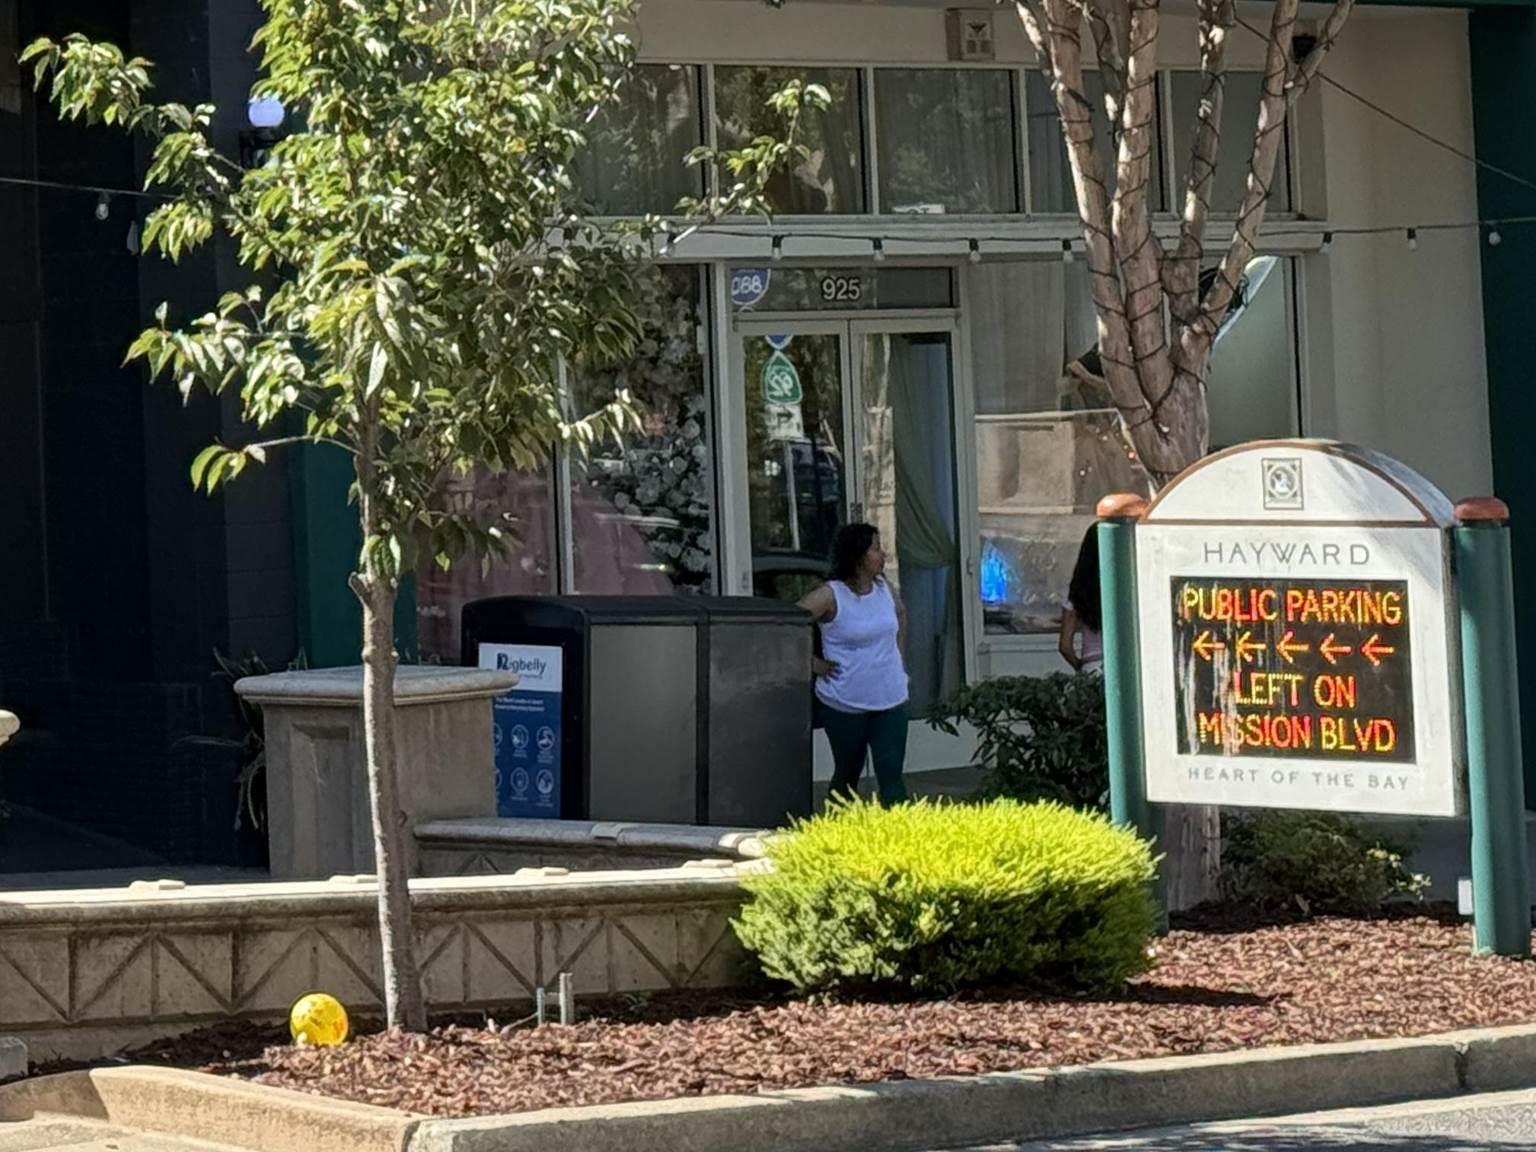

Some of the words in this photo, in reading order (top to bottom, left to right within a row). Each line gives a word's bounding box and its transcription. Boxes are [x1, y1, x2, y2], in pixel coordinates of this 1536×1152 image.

[822, 278, 860, 299] 925
[1203, 541, 1370, 566] HAYWARD
[1182, 586, 1278, 622] PUBLIC
[1286, 589, 1402, 626] PARKING
[1233, 671, 1304, 707] LEFT
[1313, 674, 1357, 709] ON
[1198, 712, 1312, 749] MISSION
[1319, 715, 1396, 753] BLVD
[1187, 767, 1260, 784] HEART
[1270, 769, 1301, 785] OF
[1311, 772, 1355, 788] THE
[1367, 774, 1409, 791] BAY
